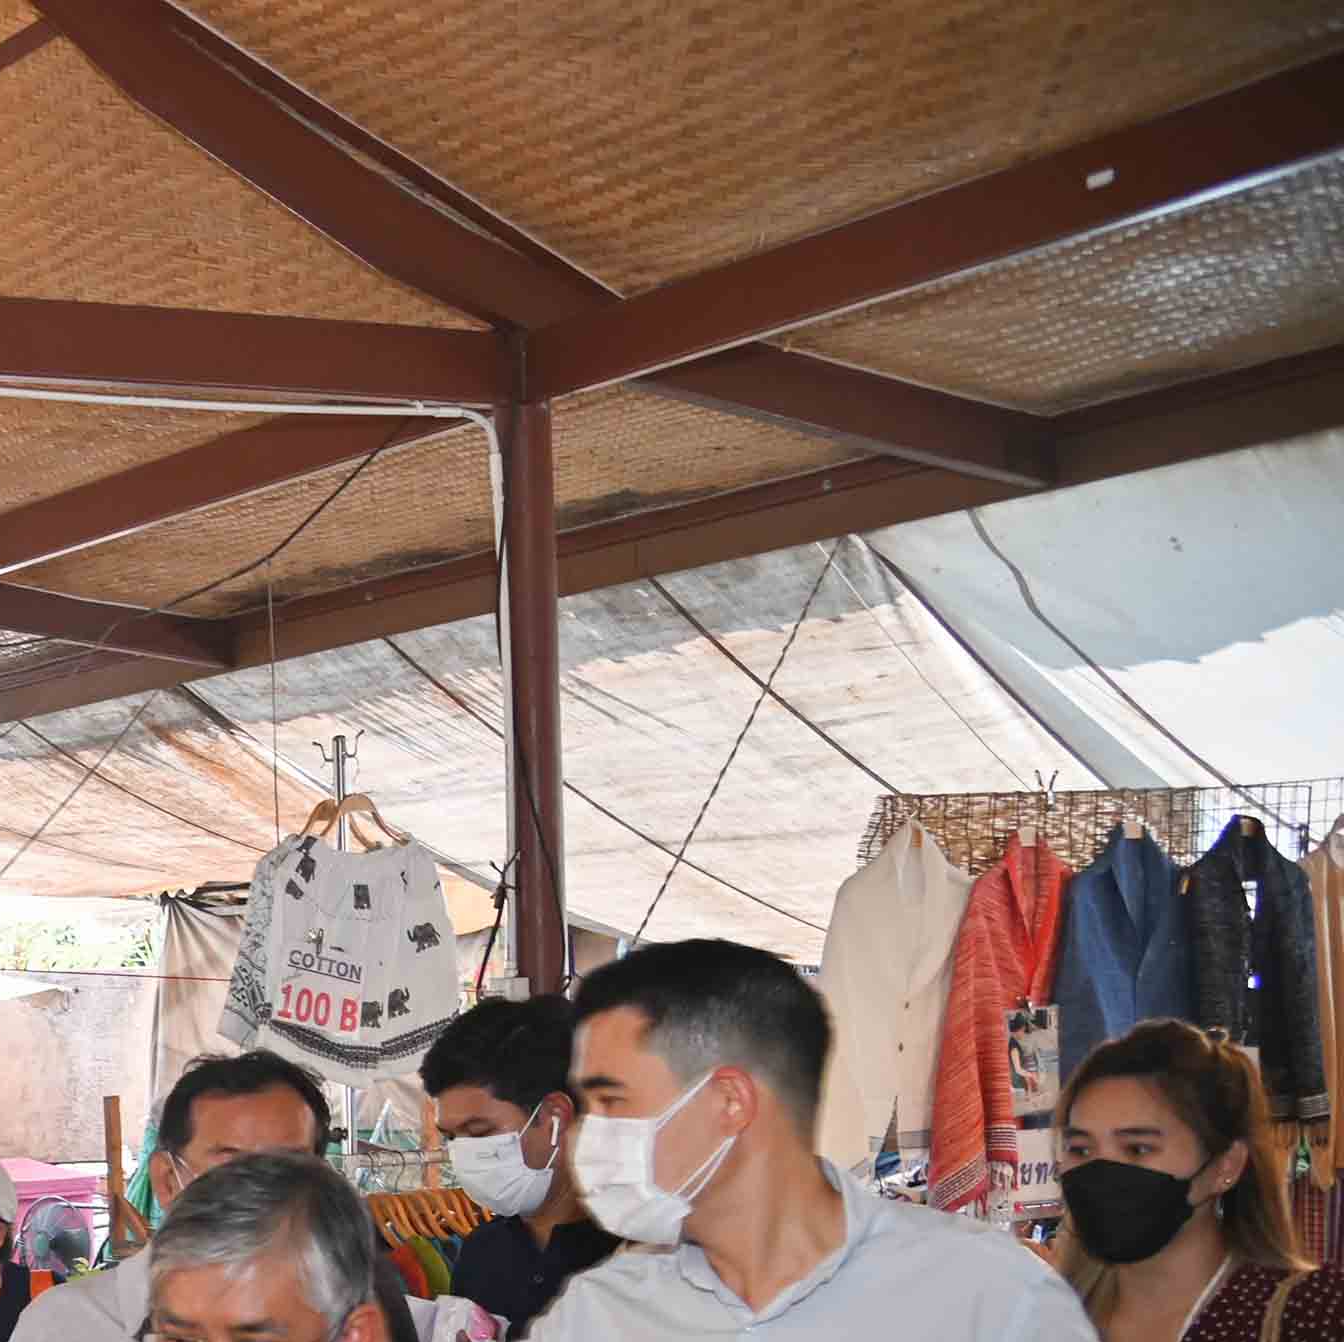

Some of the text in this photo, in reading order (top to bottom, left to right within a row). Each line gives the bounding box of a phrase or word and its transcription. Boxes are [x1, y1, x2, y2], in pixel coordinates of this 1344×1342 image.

[288, 949, 362, 982] COTTON
[277, 984, 359, 1032] 100 B
